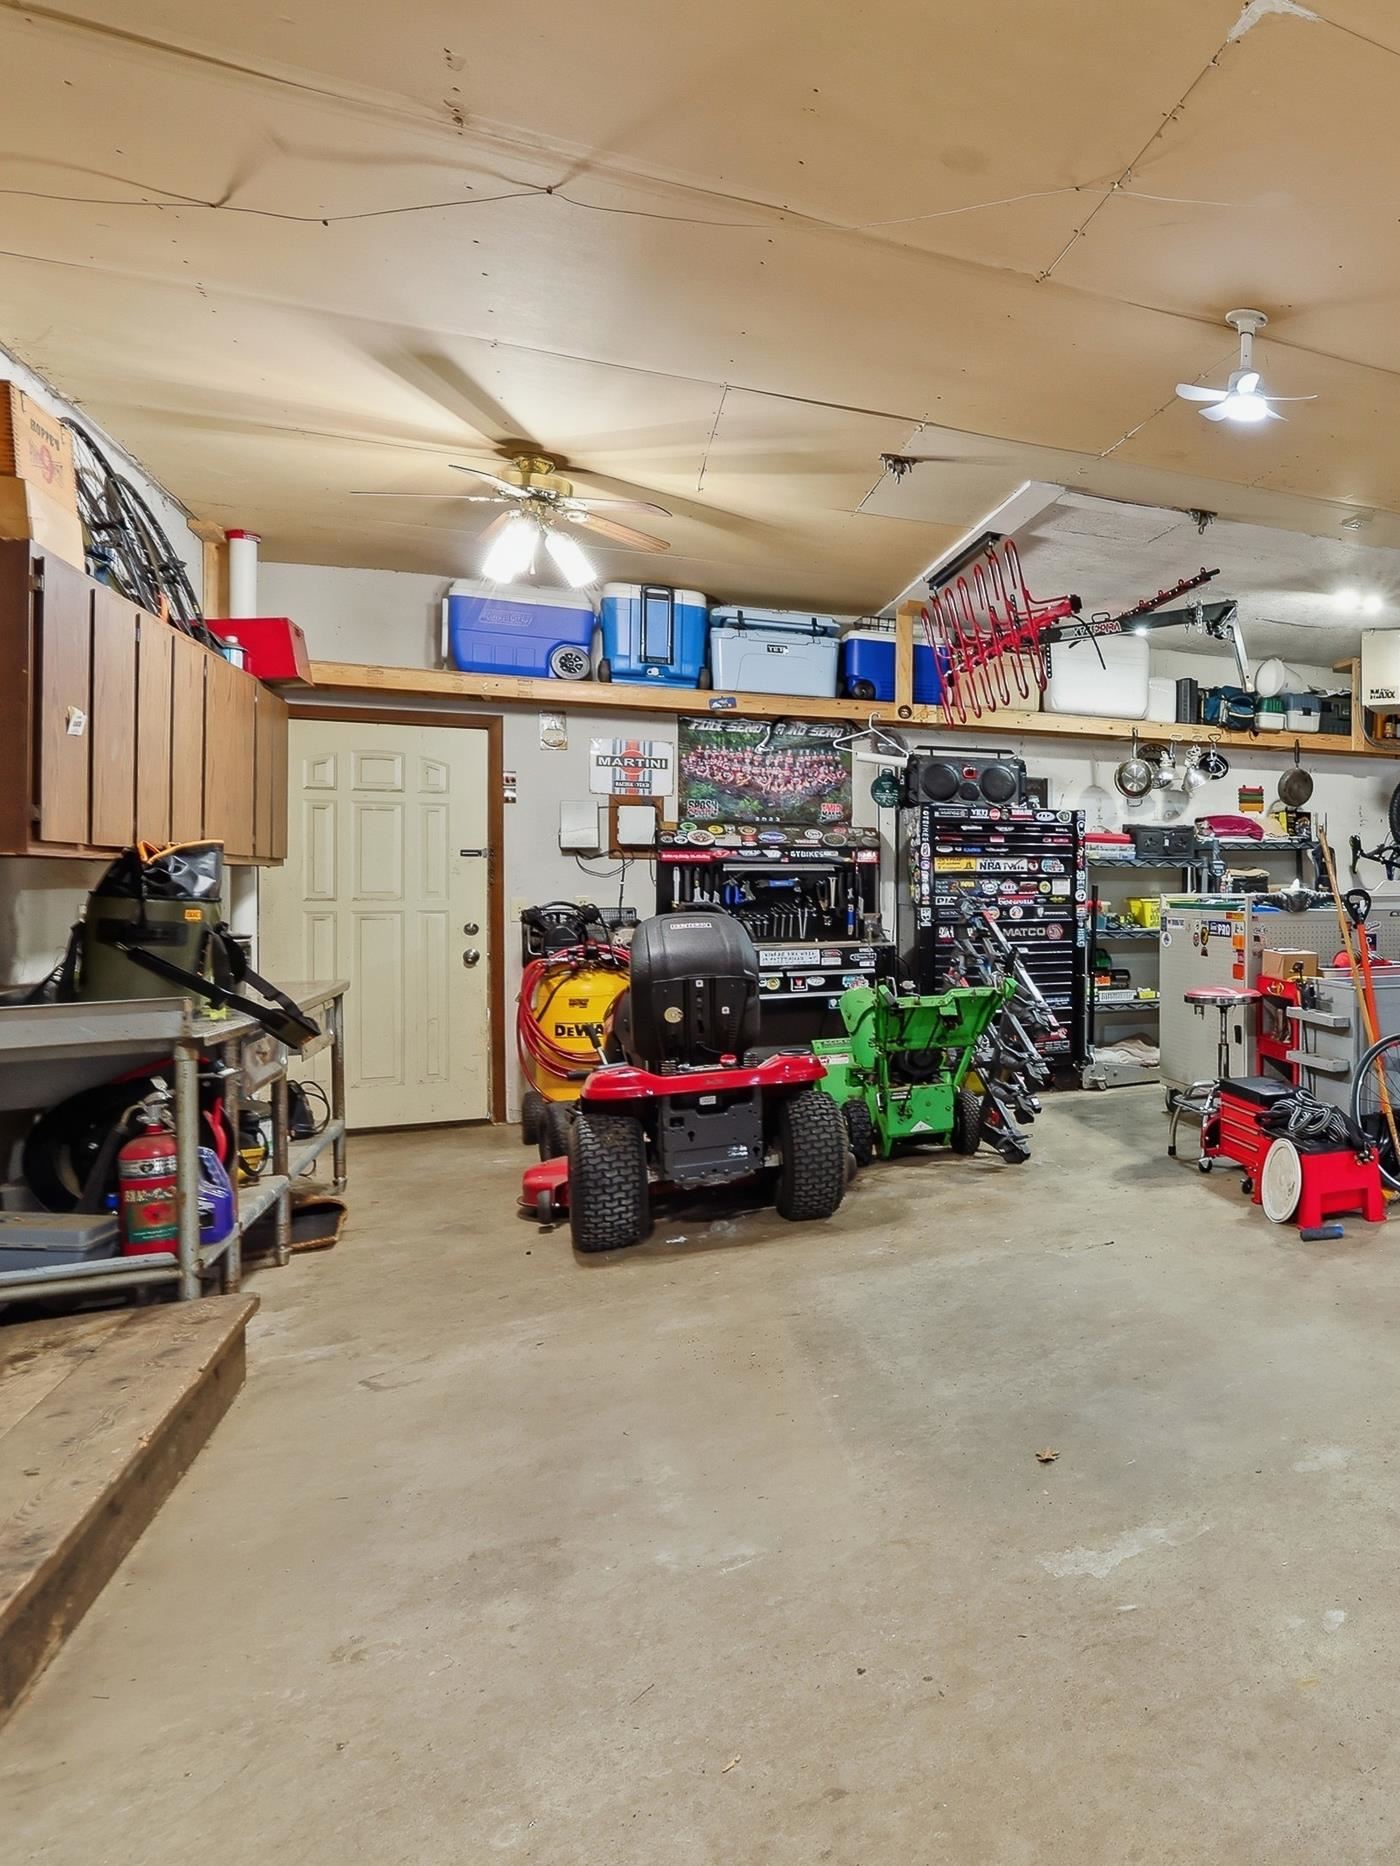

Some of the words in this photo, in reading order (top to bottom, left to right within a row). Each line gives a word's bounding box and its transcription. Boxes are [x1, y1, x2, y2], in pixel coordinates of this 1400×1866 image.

[598, 756, 666, 769] MARTINI
[980, 862, 1001, 871] NRA
[1002, 927, 1046, 937] MATCO
